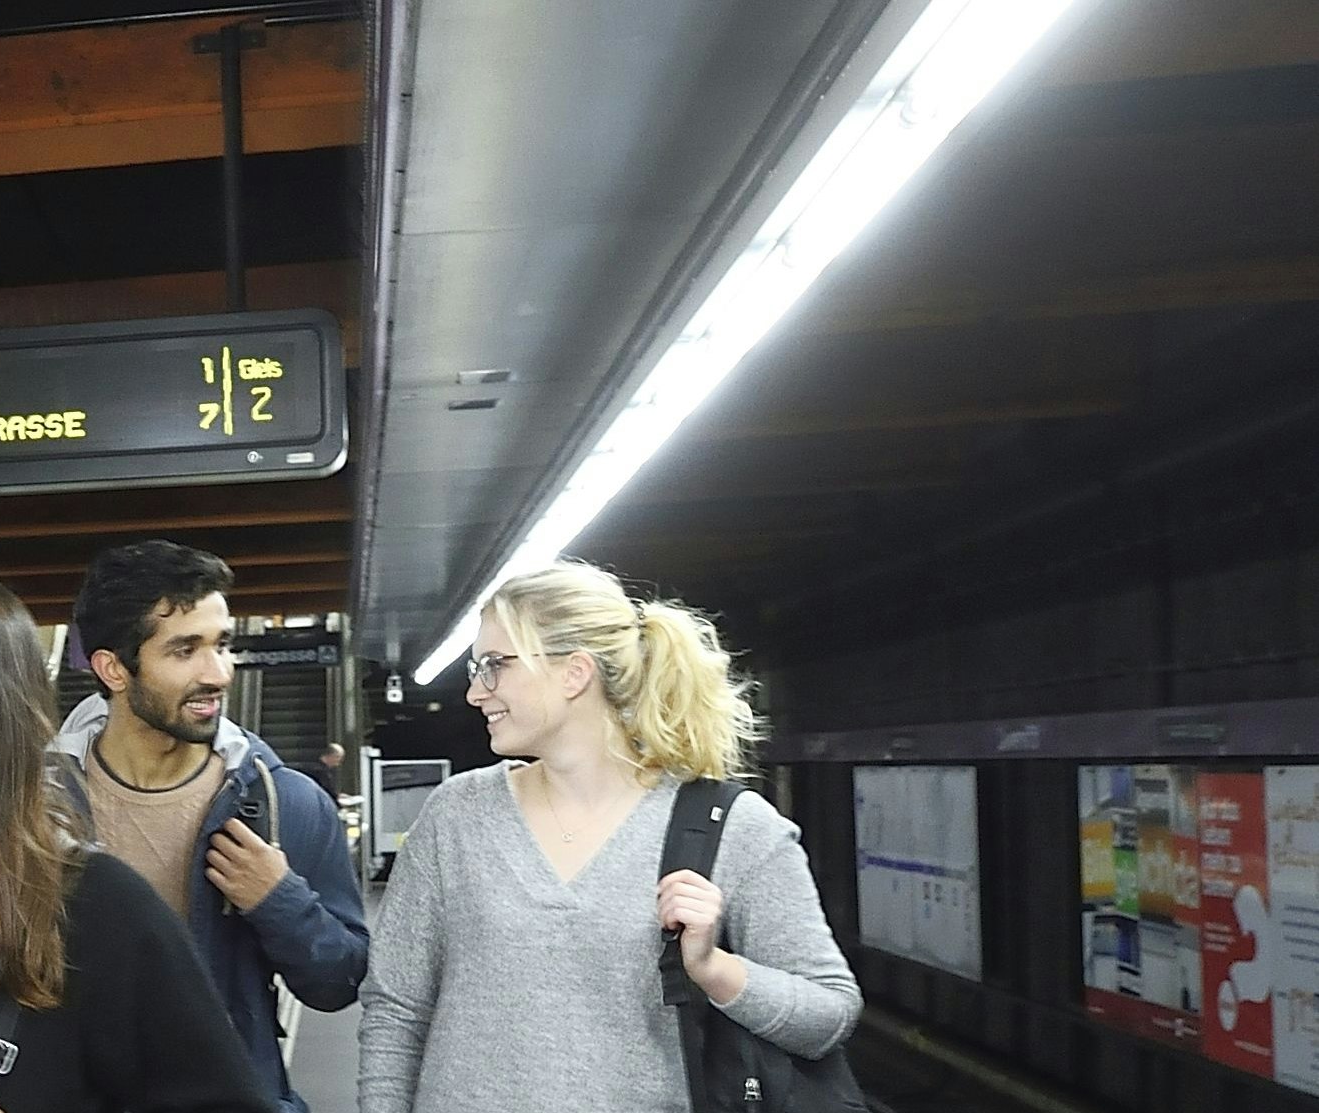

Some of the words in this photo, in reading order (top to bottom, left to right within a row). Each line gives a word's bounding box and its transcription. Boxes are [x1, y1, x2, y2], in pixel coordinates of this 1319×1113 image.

[201, 357, 215, 384] 1
[198, 402, 220, 430] 7
[250, 386, 273, 421] 2
